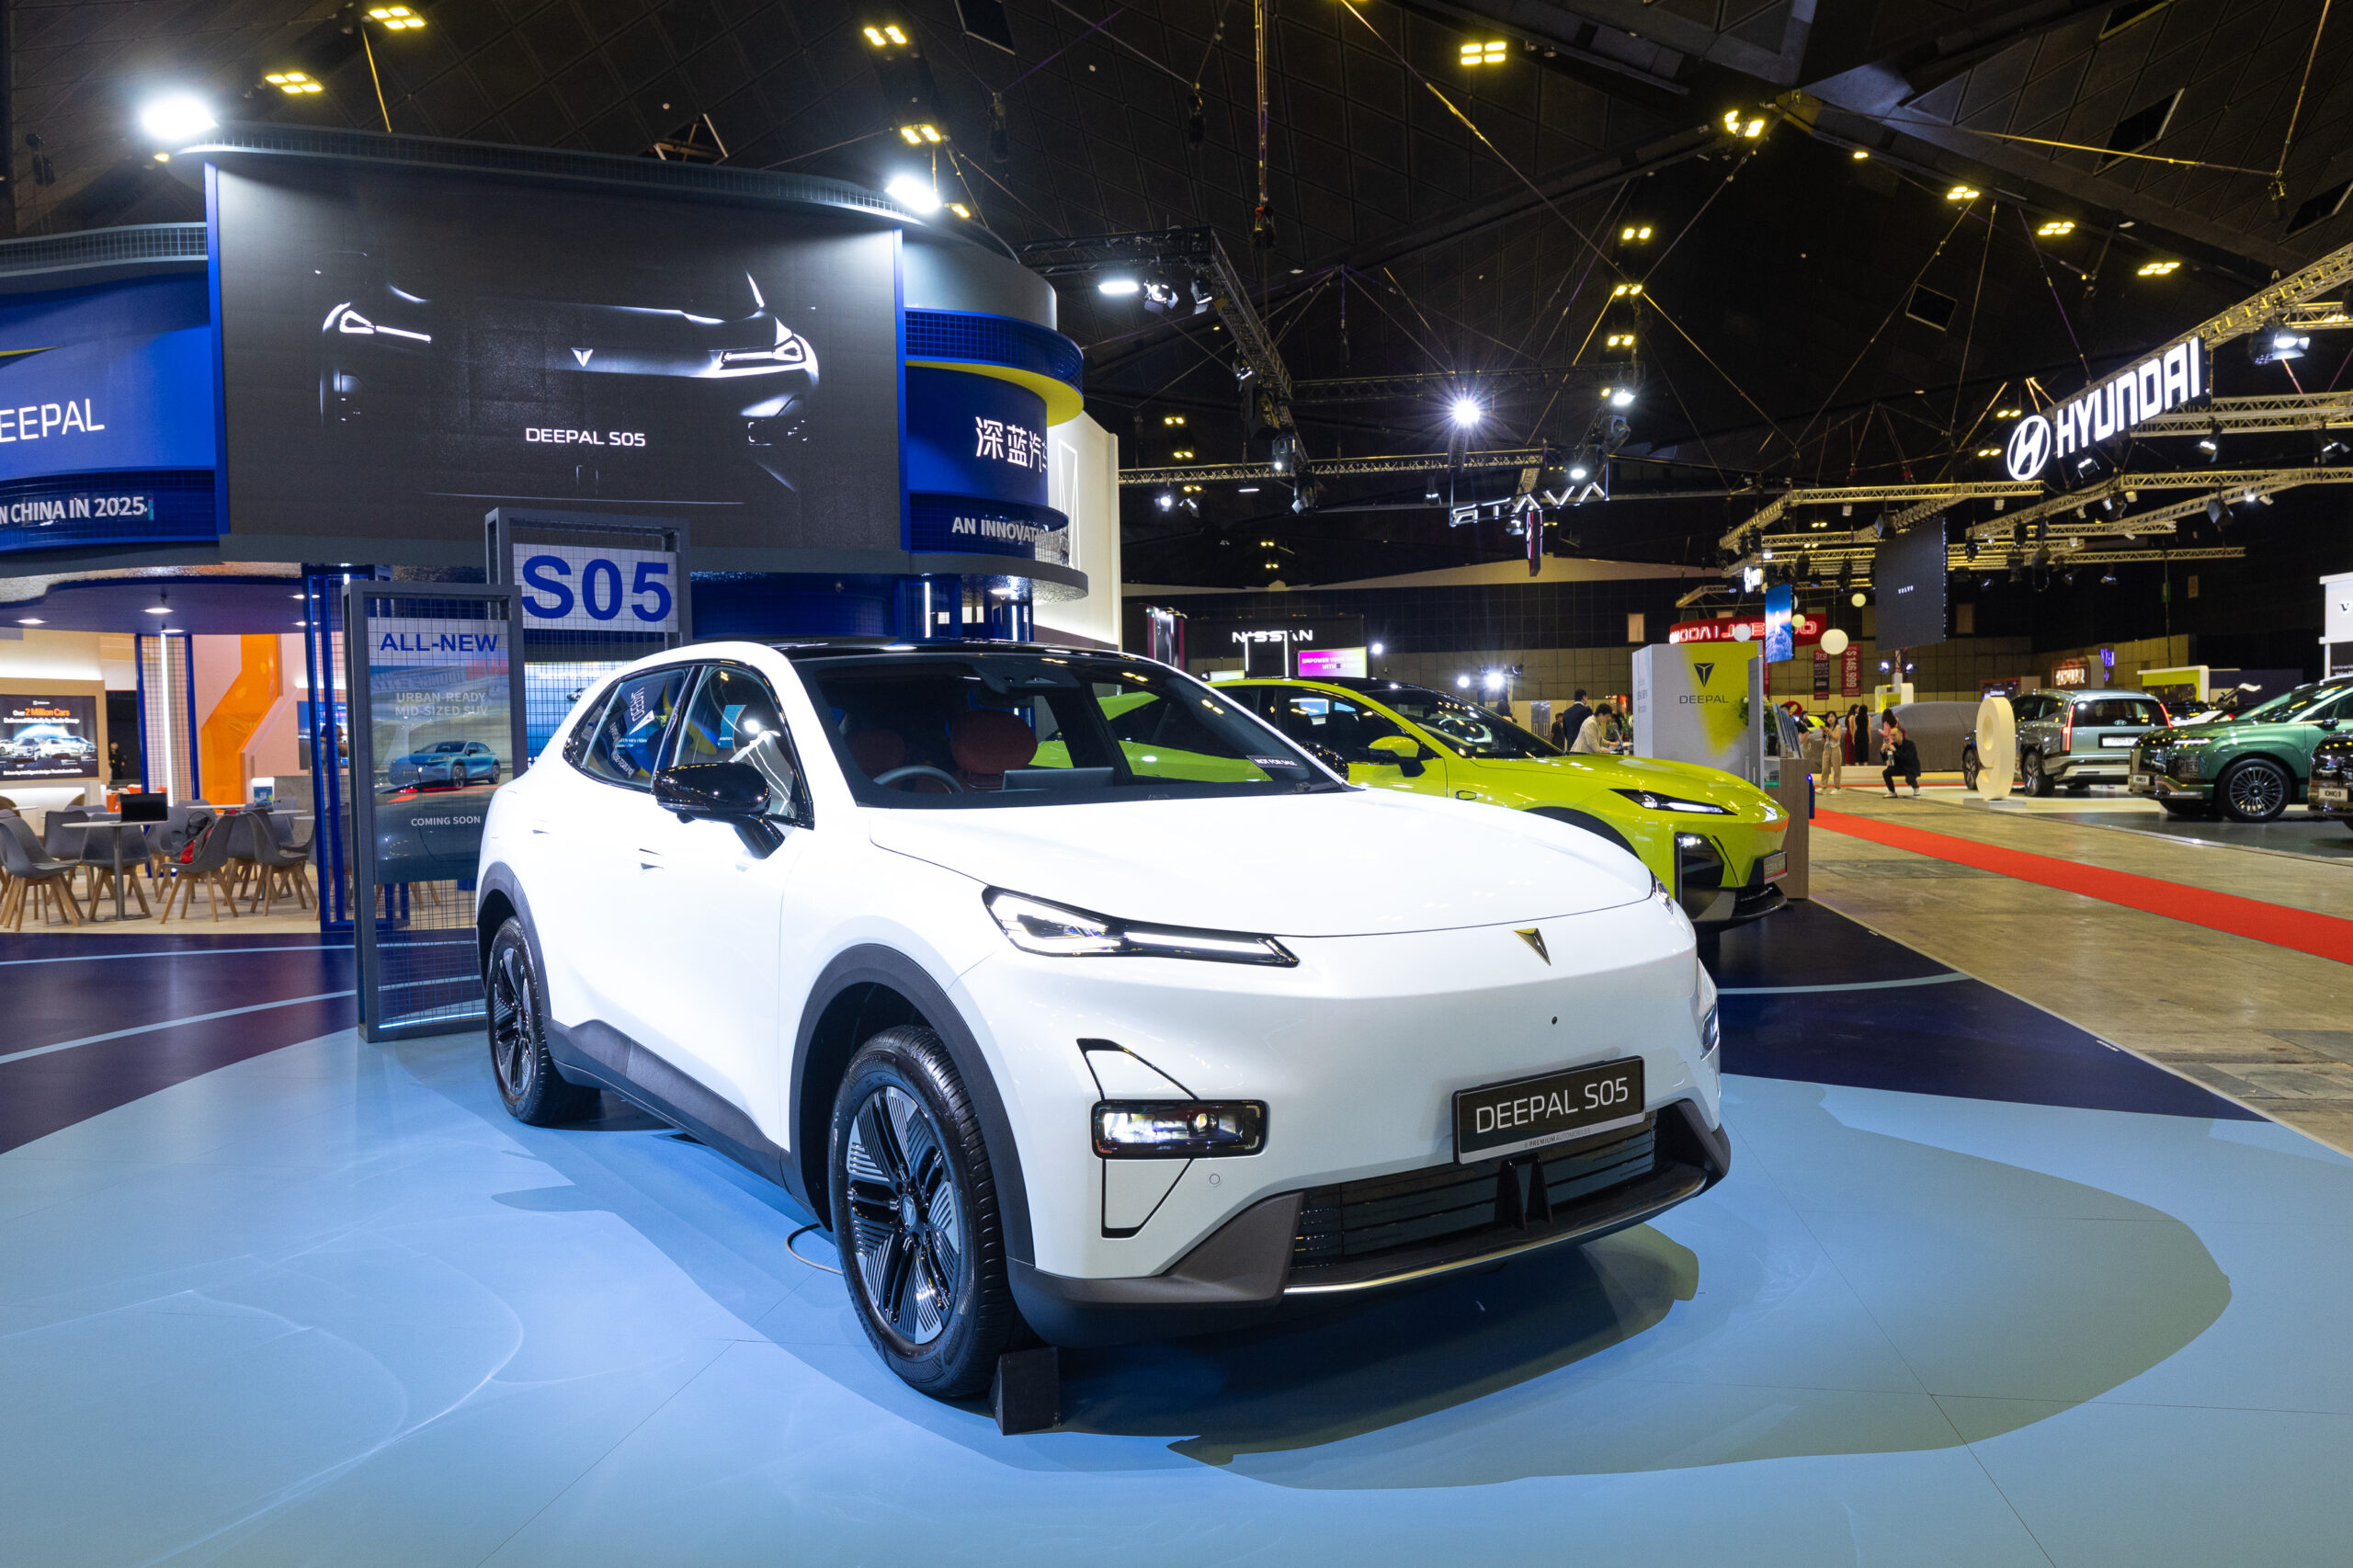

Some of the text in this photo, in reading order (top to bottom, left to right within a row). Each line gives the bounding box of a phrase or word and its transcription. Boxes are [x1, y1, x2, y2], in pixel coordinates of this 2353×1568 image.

[2057, 336, 2200, 458] HYUNDAI
[526, 427, 646, 447] DEEPAL S05
[11, 501, 66, 523] CHINA
[69, 498, 90, 518] IN
[94, 496, 144, 517] 2025
[951, 517, 976, 535] AN
[522, 555, 672, 622] S05
[380, 633, 498, 652] ALL-NEW
[396, 692, 486, 703] URBAN-READY
[1679, 694, 1729, 704] DEEPAL
[53, 708, 70, 716] Cars
[395, 705, 488, 716] MID-SIZED SUV
[411, 815, 481, 826] COMING SOON
[1476, 1076, 1629, 1134] DEEPAL S05
[1529, 1127, 1591, 1147] PREMIUM AUTOMOBILES
